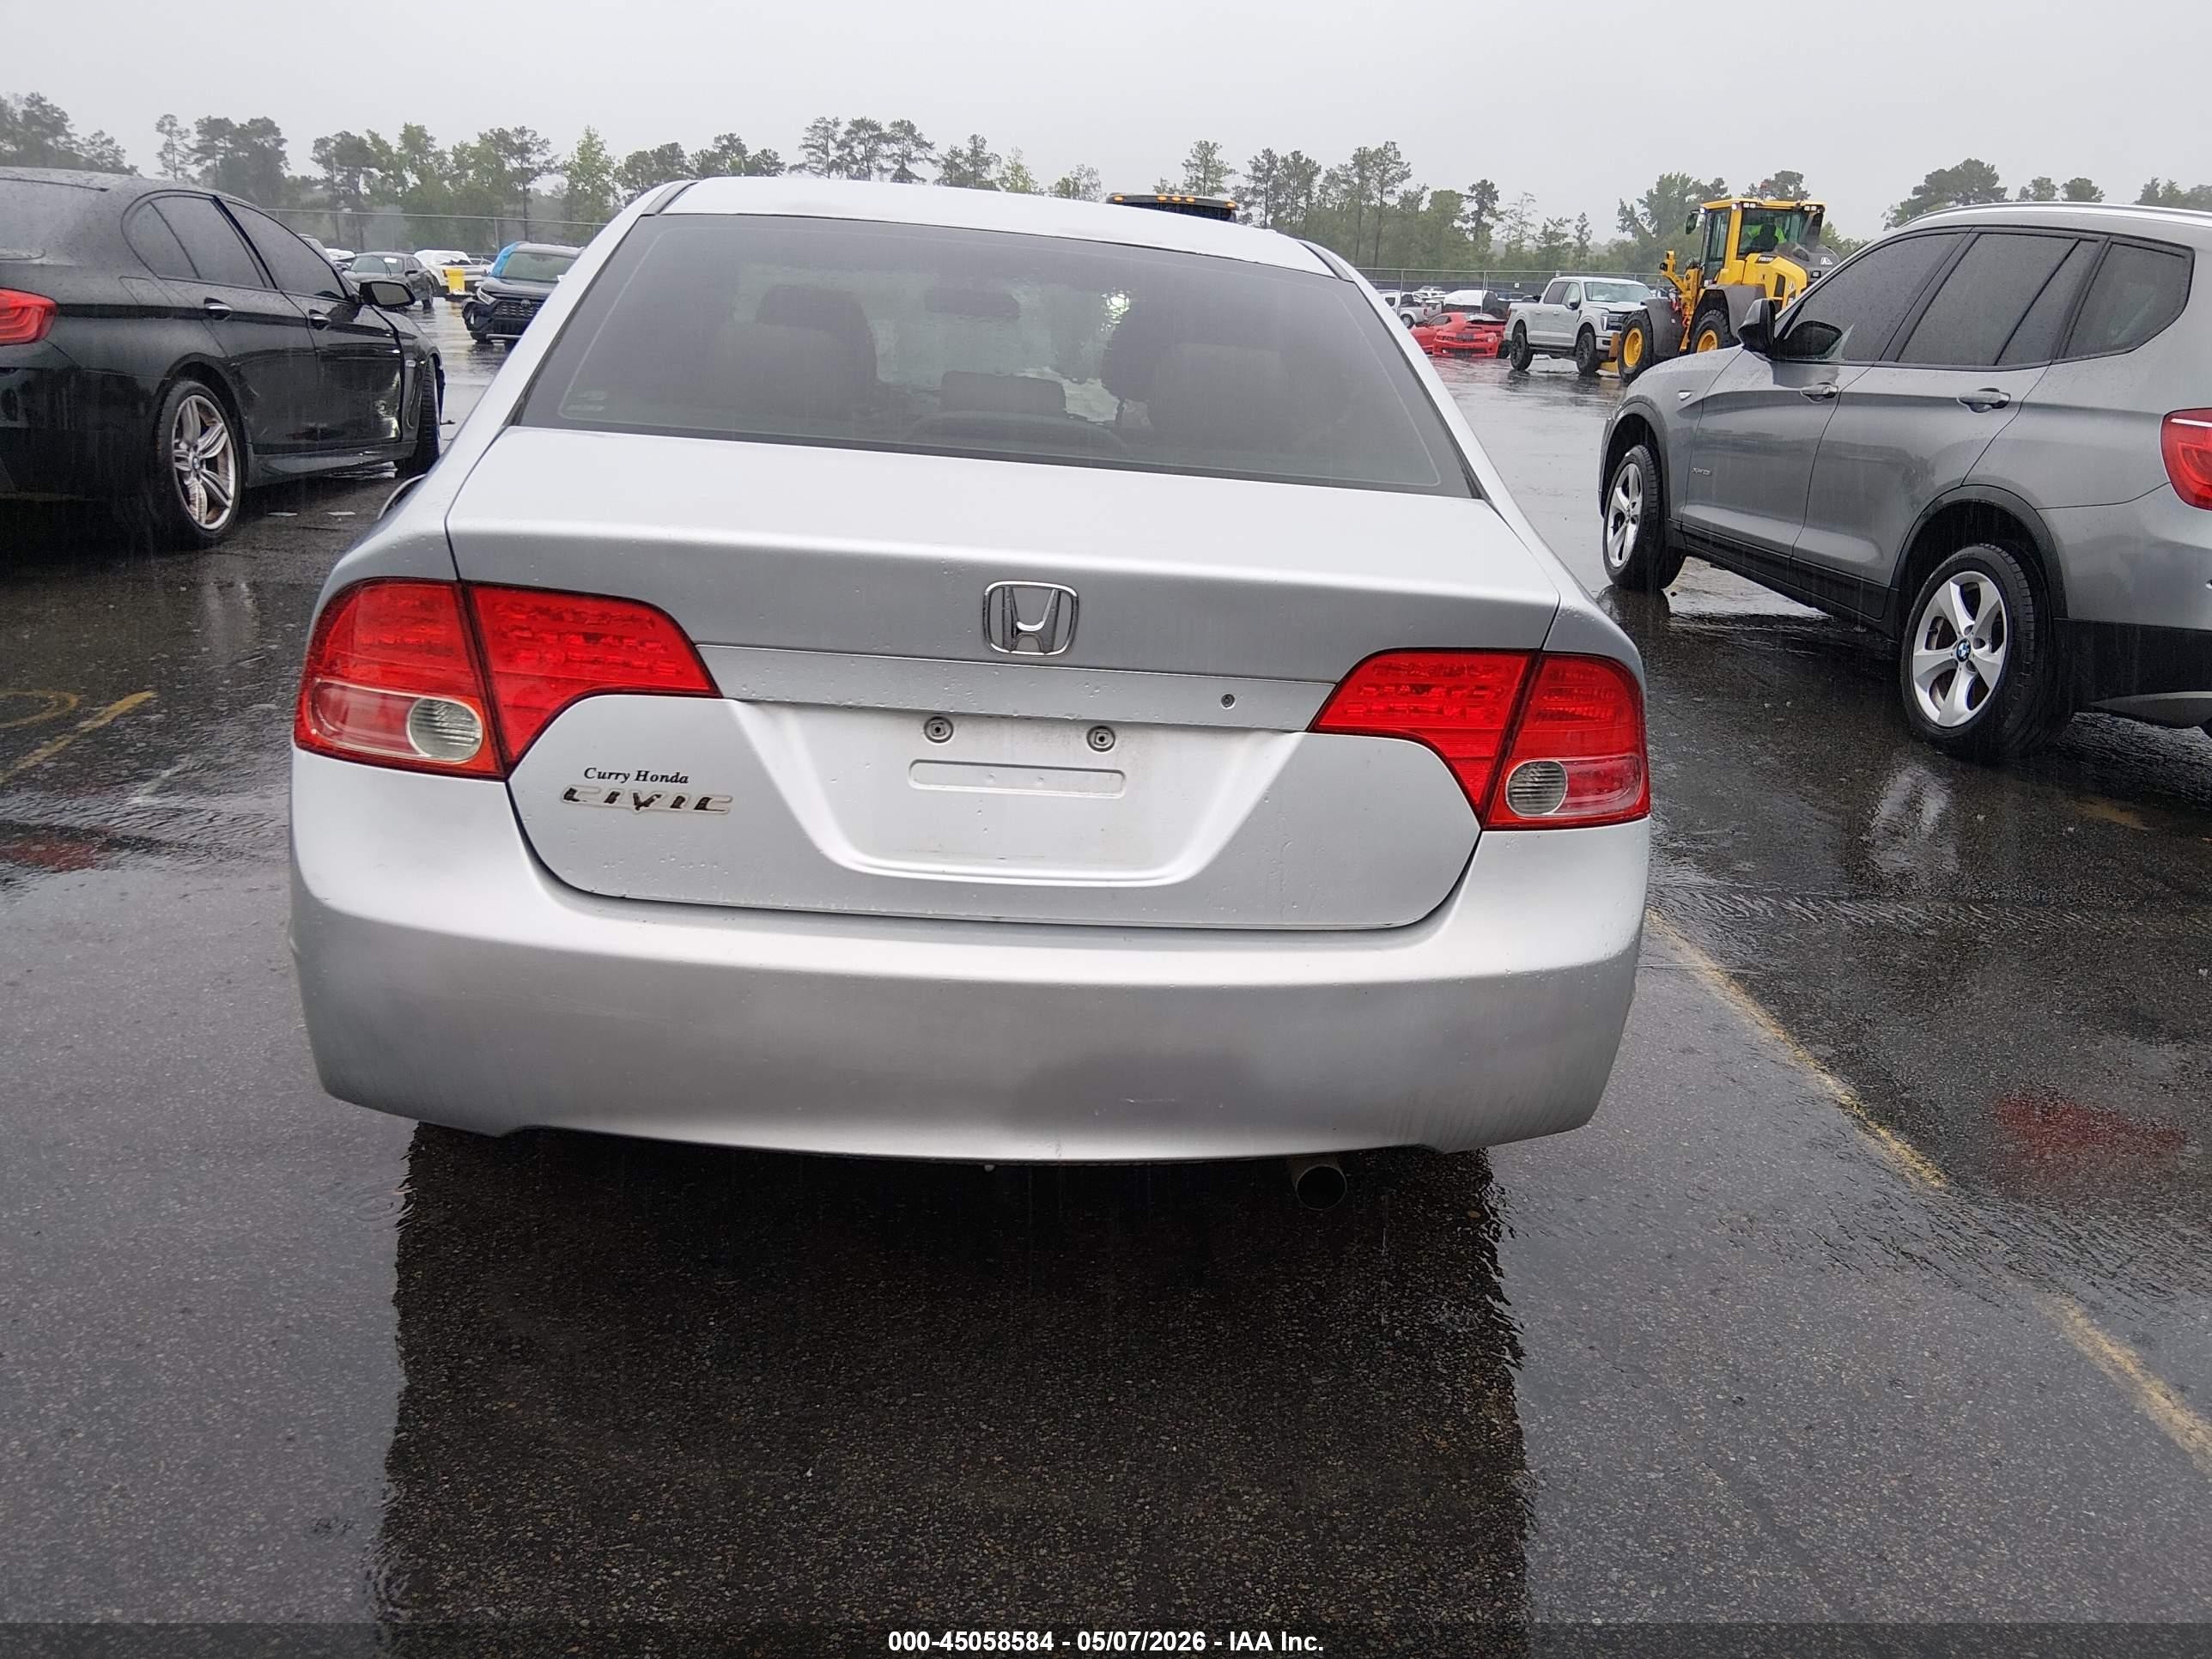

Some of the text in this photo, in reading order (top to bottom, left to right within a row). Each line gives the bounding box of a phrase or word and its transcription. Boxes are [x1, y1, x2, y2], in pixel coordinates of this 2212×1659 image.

[584, 767, 689, 784] Curry Honda
[562, 786, 732, 815] CIVIC
